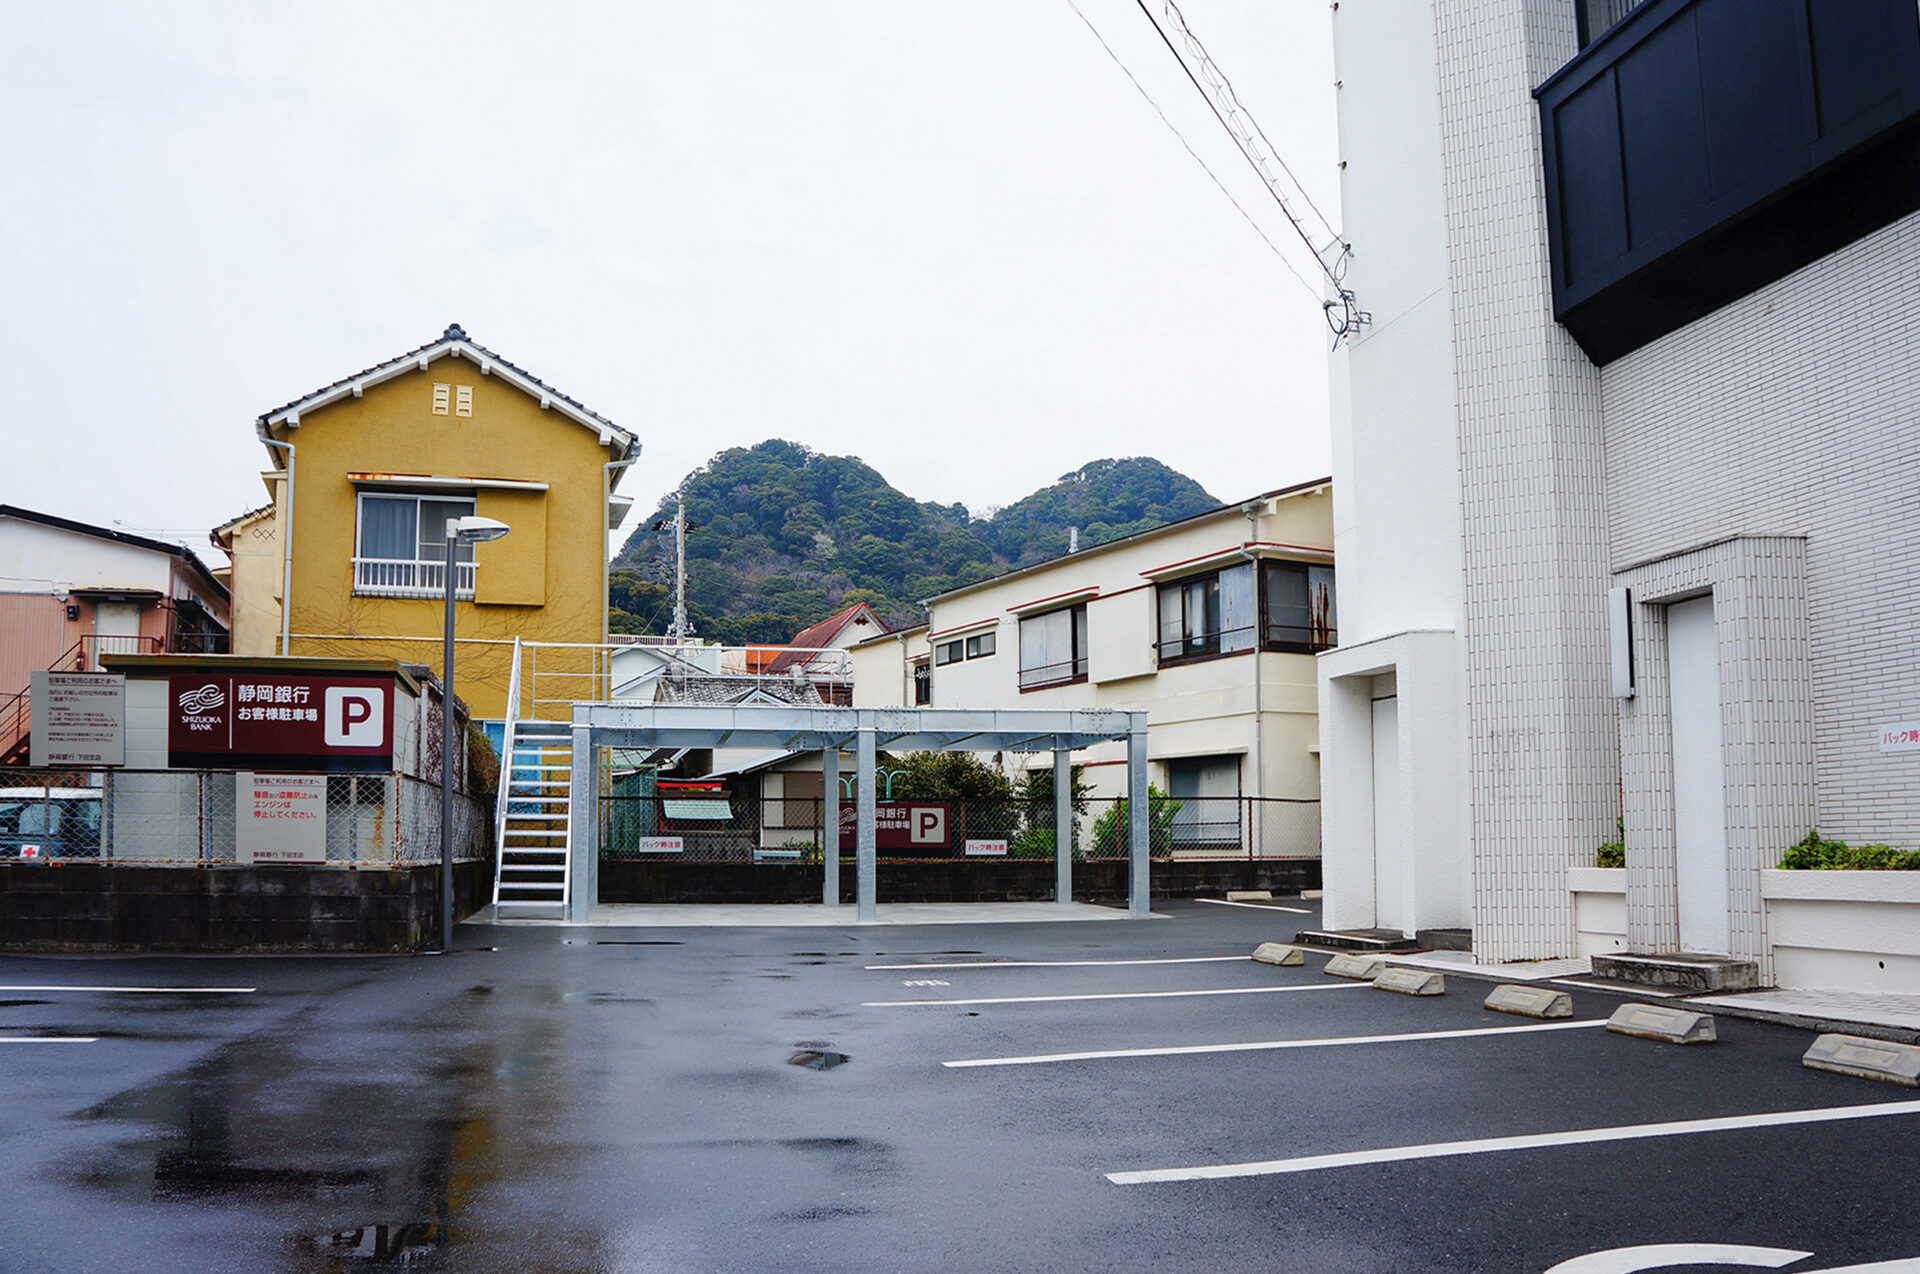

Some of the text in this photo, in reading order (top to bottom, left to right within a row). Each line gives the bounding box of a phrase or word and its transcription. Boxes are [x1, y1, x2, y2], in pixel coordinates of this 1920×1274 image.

[237, 684, 310, 704] 静岡銀行
[181, 715, 222, 724] SHIZUOKA
[237, 707, 318, 722] お客様駐車場
[341, 696, 371, 736] P
[1883, 730, 1920, 745] バック時
[254, 801, 291, 809] エンジンは
[875, 807, 907, 819] 岡銀行
[920, 812, 939, 839] P
[642, 841, 681, 849] バック時注意
